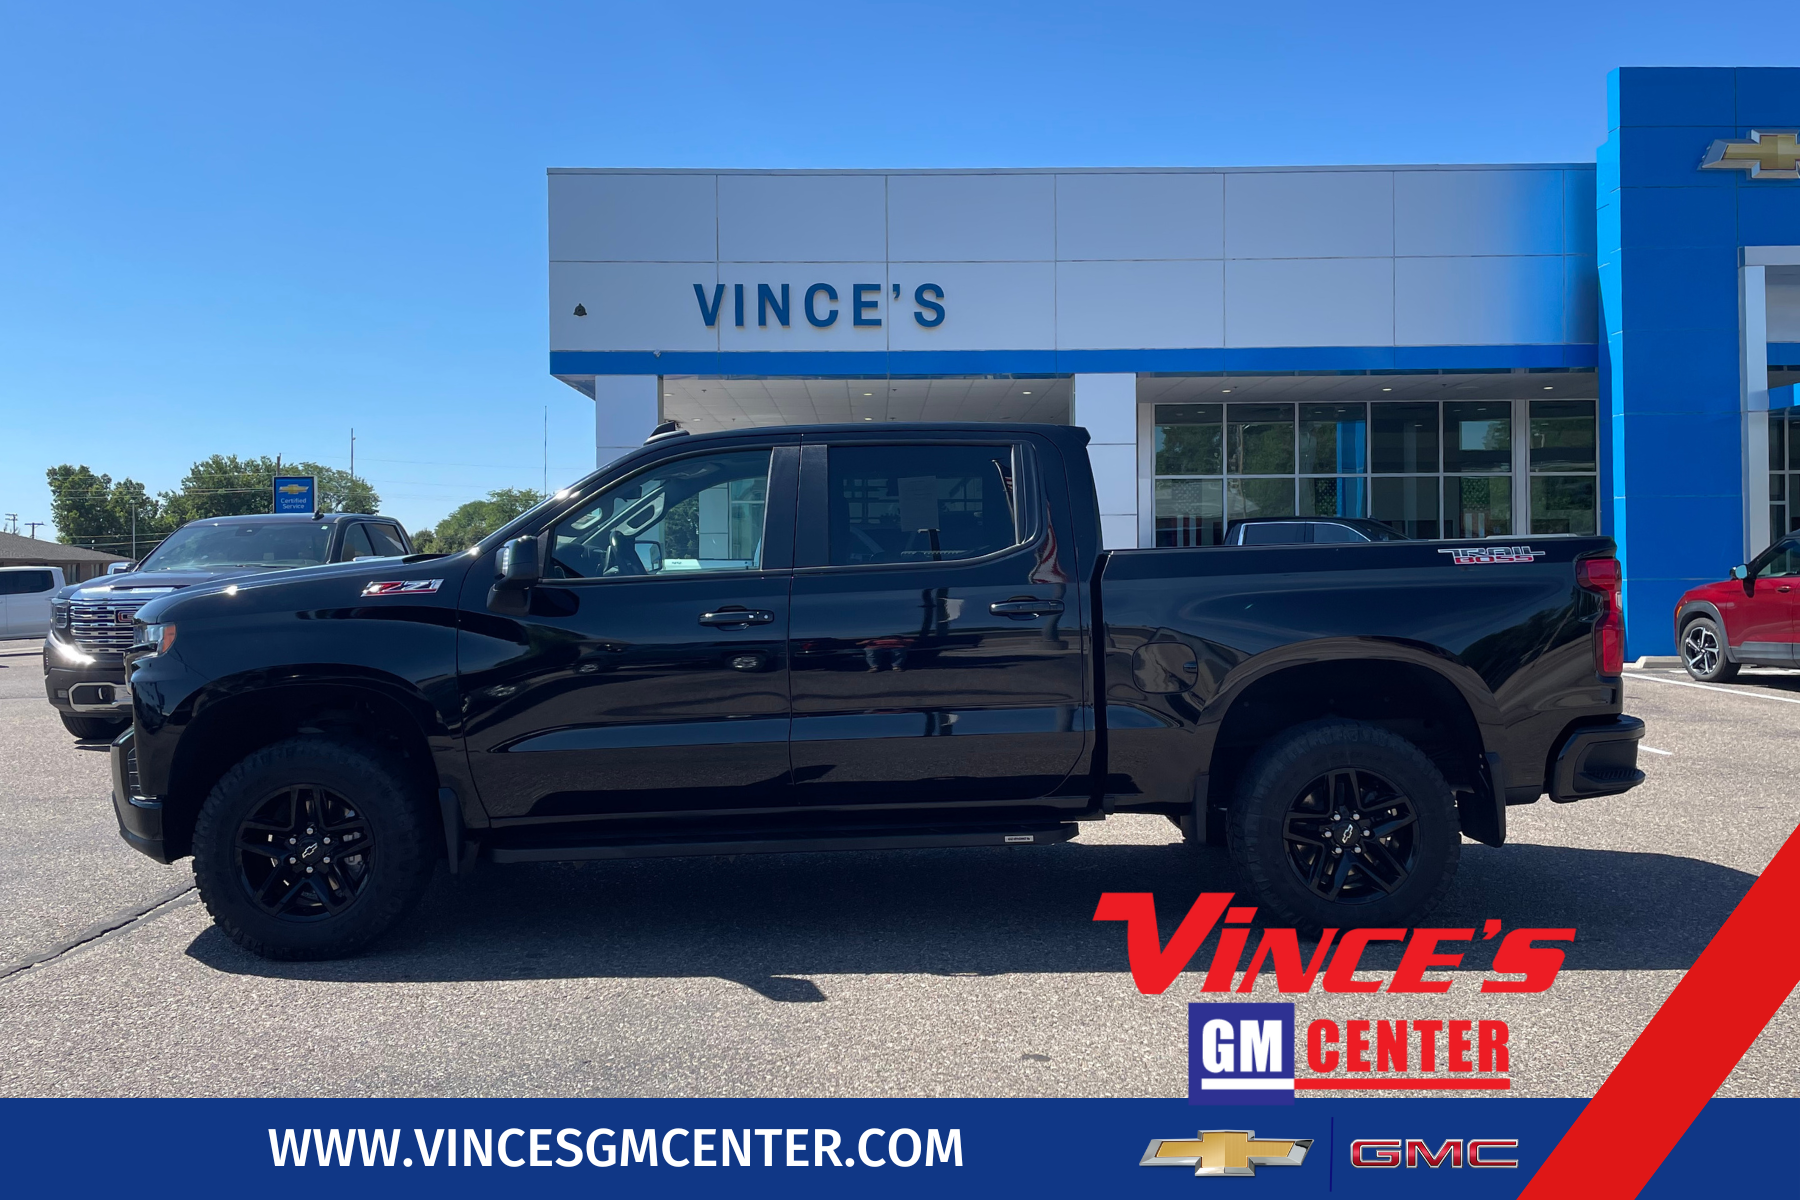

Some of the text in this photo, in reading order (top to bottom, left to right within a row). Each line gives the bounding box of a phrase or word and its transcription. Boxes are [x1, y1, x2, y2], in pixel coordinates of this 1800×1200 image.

[693, 282, 946, 328] VINCE'S
[1437, 546, 1546, 556] TRAIL
[1454, 555, 1534, 564] BOSS
[360, 578, 444, 597] Z71
